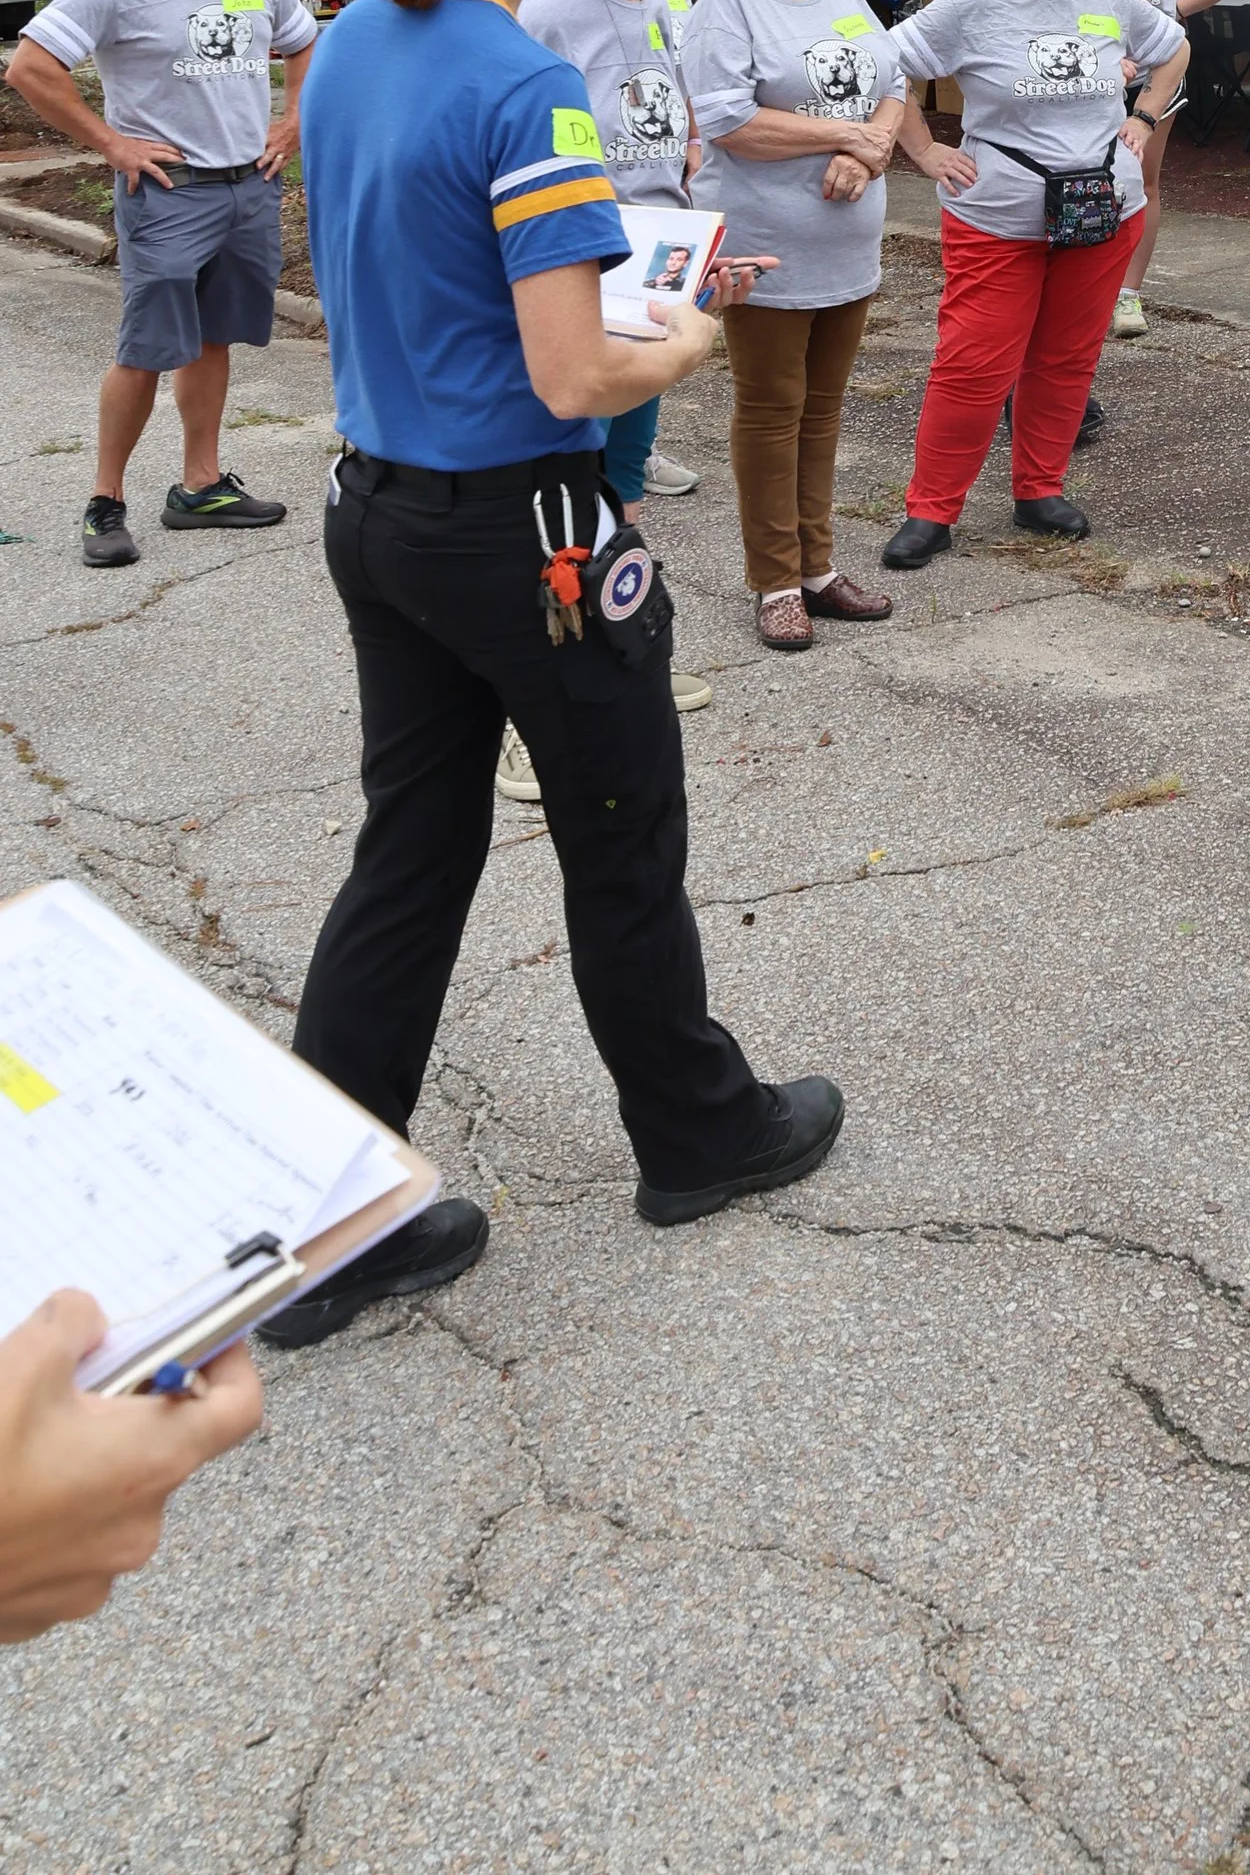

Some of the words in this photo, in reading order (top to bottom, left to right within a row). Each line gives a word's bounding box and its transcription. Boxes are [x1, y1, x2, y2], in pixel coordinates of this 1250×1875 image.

[172, 58, 228, 77] Street
[231, 57, 267, 75] Dog
[1014, 78, 1076, 97] Street
[1080, 77, 1116, 96] Dog
[1028, 94, 1105, 104] COALITION
[605, 137, 666, 163] Street
[667, 136, 688, 160] Do
